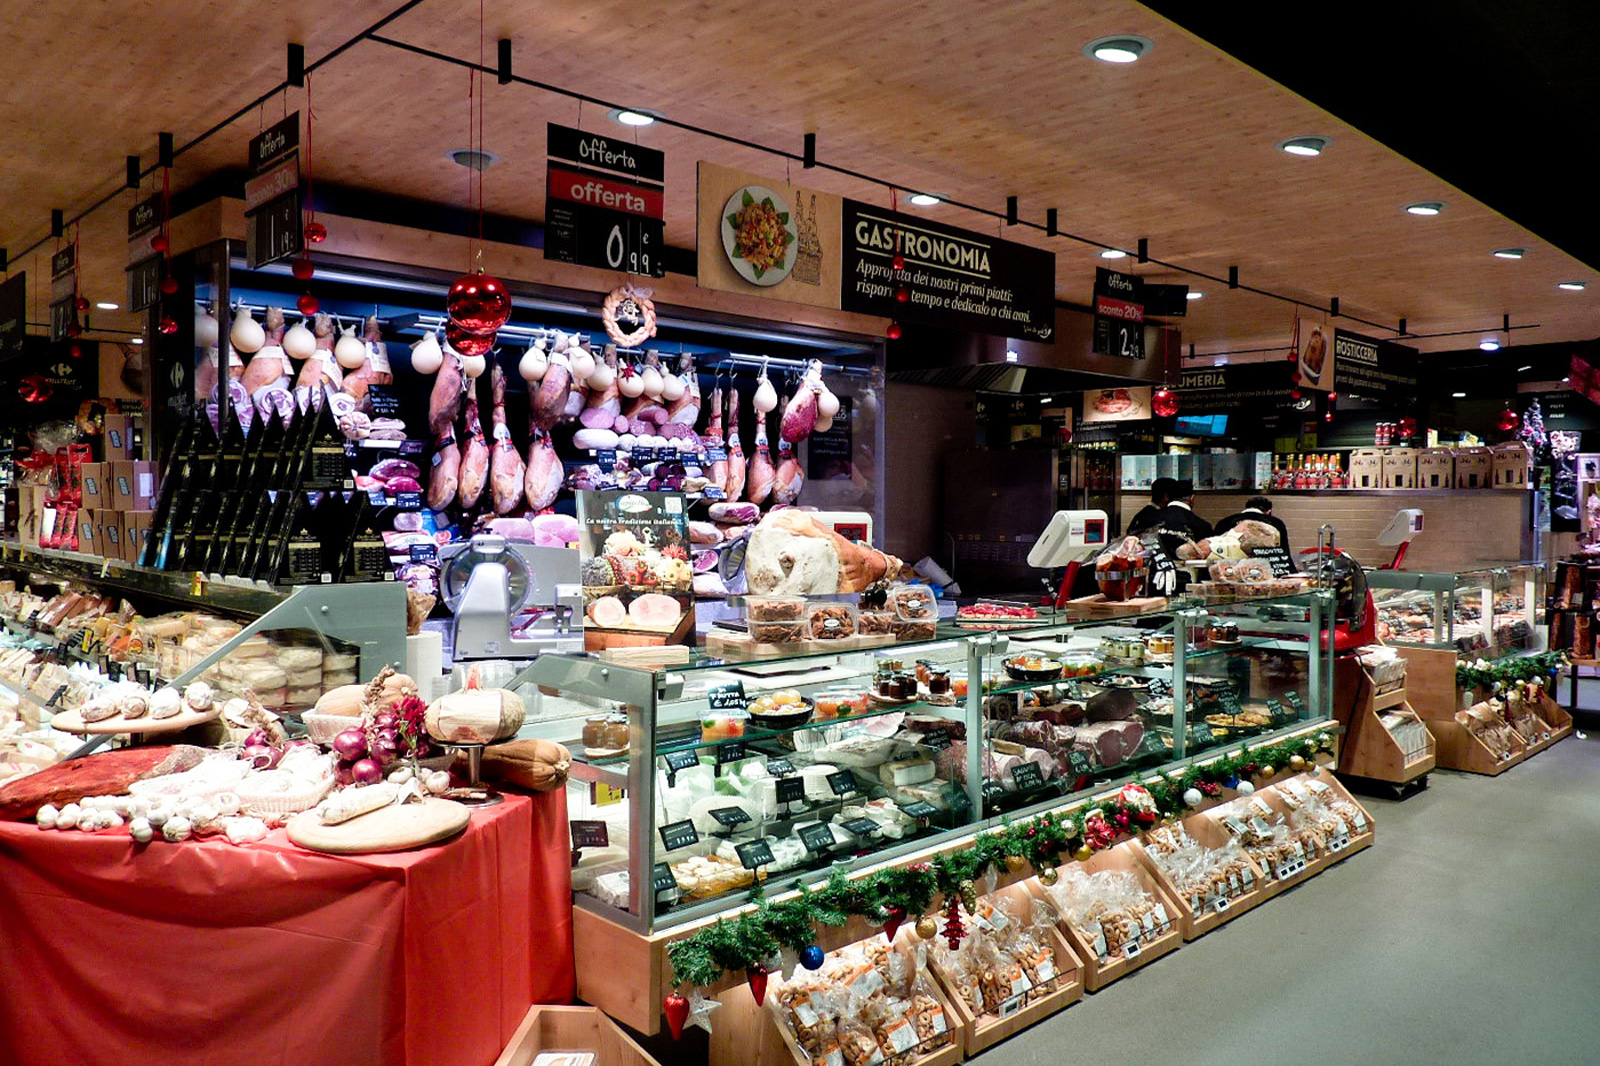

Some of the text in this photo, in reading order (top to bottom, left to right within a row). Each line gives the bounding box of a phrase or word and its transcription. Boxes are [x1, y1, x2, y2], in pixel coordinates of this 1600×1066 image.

[260, 131, 286, 158] Offerta
[579, 138, 636, 168] Offerta
[571, 182, 645, 212] offerta
[855, 221, 991, 273] GASTRONOMIA
[913, 269, 929, 285] dei
[930, 276, 959, 293] nostri
[960, 281, 986, 297] primi
[911, 289, 942, 309] tempo
[944, 298, 950, 308] e
[951, 296, 990, 316] dedicalo
[998, 305, 1012, 320] chi
[1336, 340, 1378, 362] ROSTICCERIA
